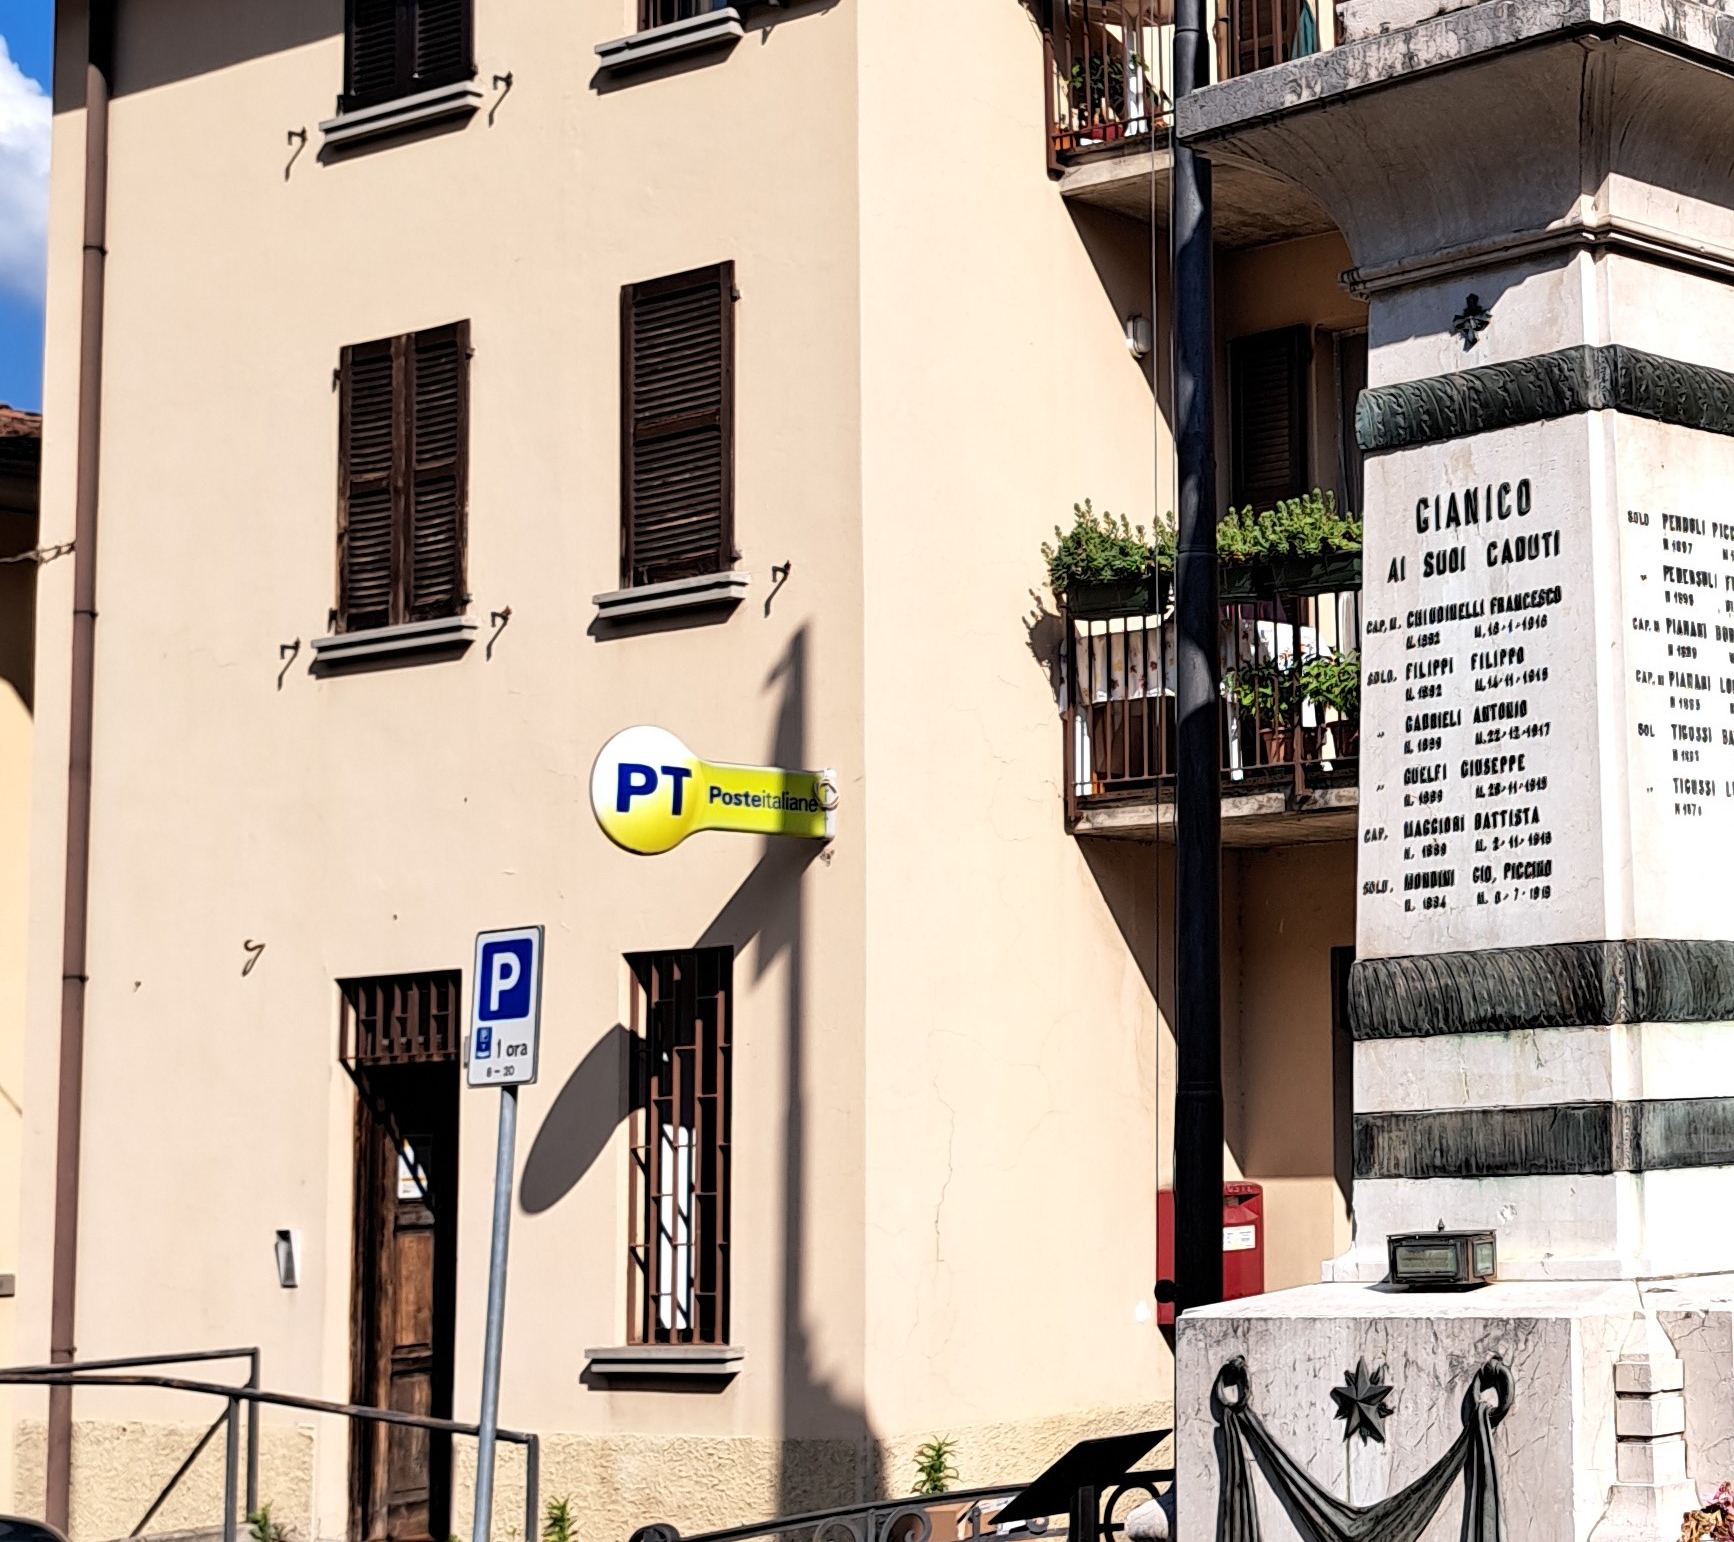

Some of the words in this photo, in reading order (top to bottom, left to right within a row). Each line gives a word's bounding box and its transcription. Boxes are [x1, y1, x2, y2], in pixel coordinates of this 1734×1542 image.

[1416, 478, 1531, 534] GIANICO
[1387, 556, 1406, 583] AI
[1423, 546, 1466, 577] SUOI
[1487, 530, 1560, 567] CADUTI
[1490, 586, 1562, 614] FRANCESCO
[1406, 657, 1453, 680] FILIPPI
[1471, 647, 1524, 670] FILIPPO
[1473, 700, 1527, 724] ANTONIO
[1404, 763, 1447, 785] GUELFI
[1461, 754, 1525, 778] GIUSEPPE
[616, 763, 692, 816] PT
[1474, 806, 1540, 831] BATTISTA
[1404, 869, 1455, 891] MONDINI
[1504, 860, 1552, 880] PICCINO
[490, 952, 521, 1011] P
[506, 1043, 528, 1057] ora
